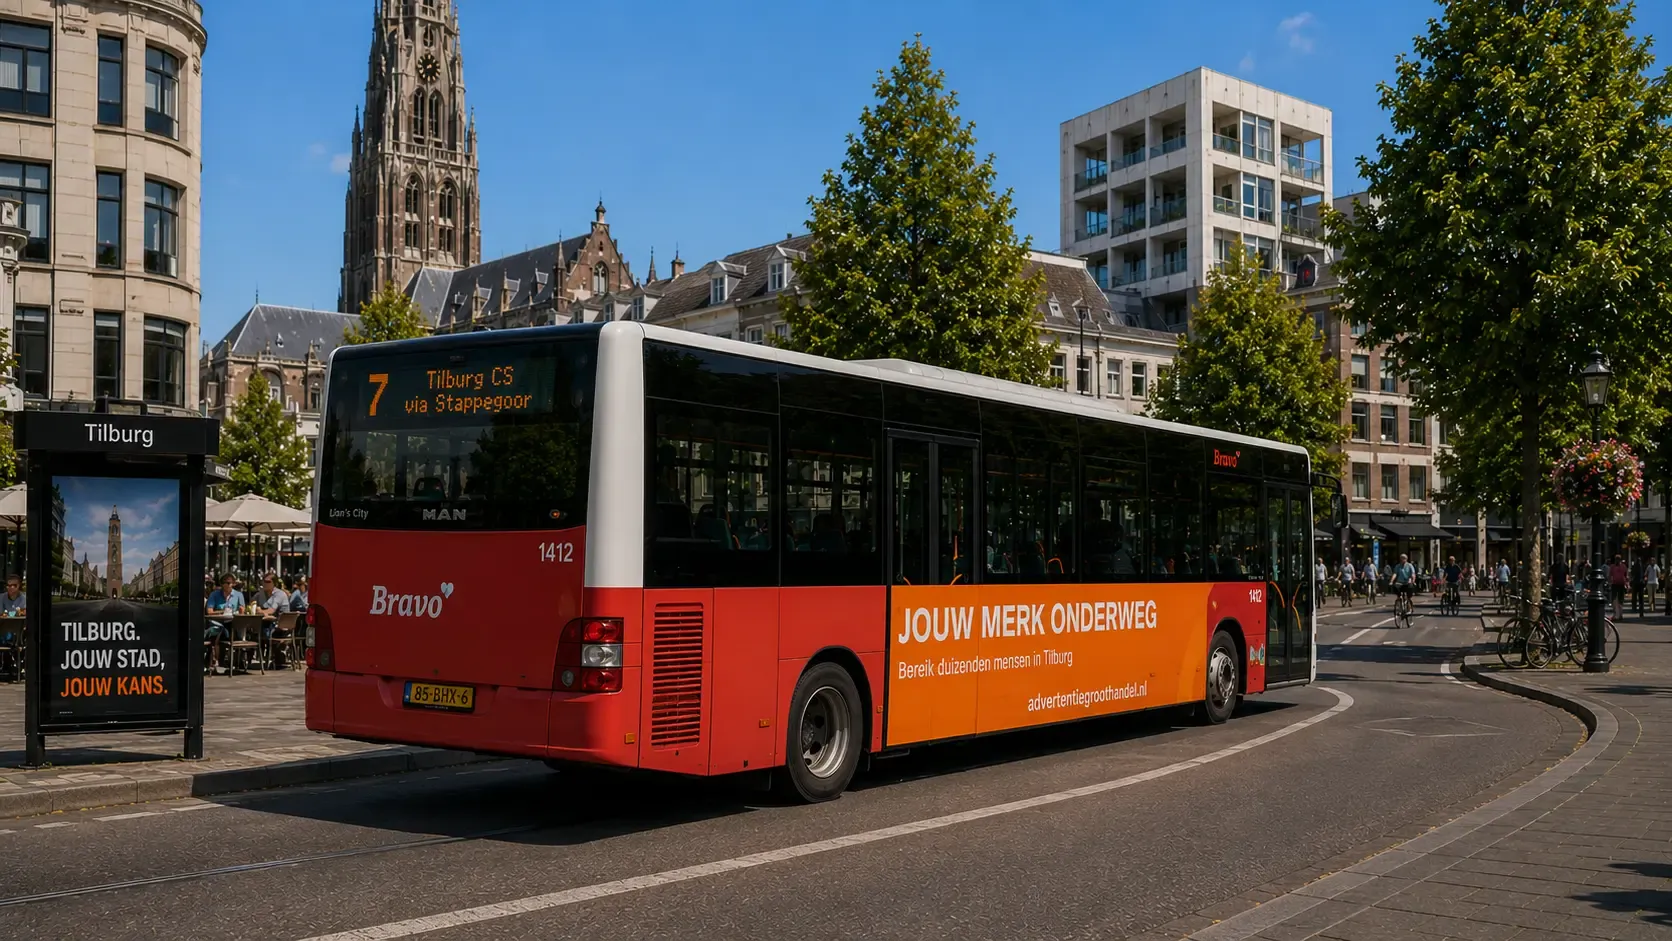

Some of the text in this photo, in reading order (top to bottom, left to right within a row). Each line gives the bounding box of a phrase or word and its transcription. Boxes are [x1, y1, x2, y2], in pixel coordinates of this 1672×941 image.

[426, 366, 514, 390] Tilburg CS
[368, 373, 389, 416] 7
[405, 393, 533, 414] via Stappegoor
[84, 423, 154, 447] Tilburg
[1213, 449, 1237, 468] Bravo
[352, 508, 369, 520] City
[422, 508, 467, 521] MAN
[538, 542, 574, 563] 1412
[369, 584, 444, 619] Bravo
[61, 621, 141, 642] TILBURG.
[898, 599, 1157, 644] JOUW MERK ONDERWEG
[60, 648, 166, 671] JOUW STAD,
[898, 660, 935, 680] Bereik
[937, 655, 991, 676] duizenden
[993, 653, 1031, 670] mensen
[1033, 650, 1041, 667] in
[60, 675, 168, 698] JOUW KANS.
[414, 685, 469, 705] 85-BHX-6
[1027, 680, 1148, 712] advertentiegroothandel.nl
